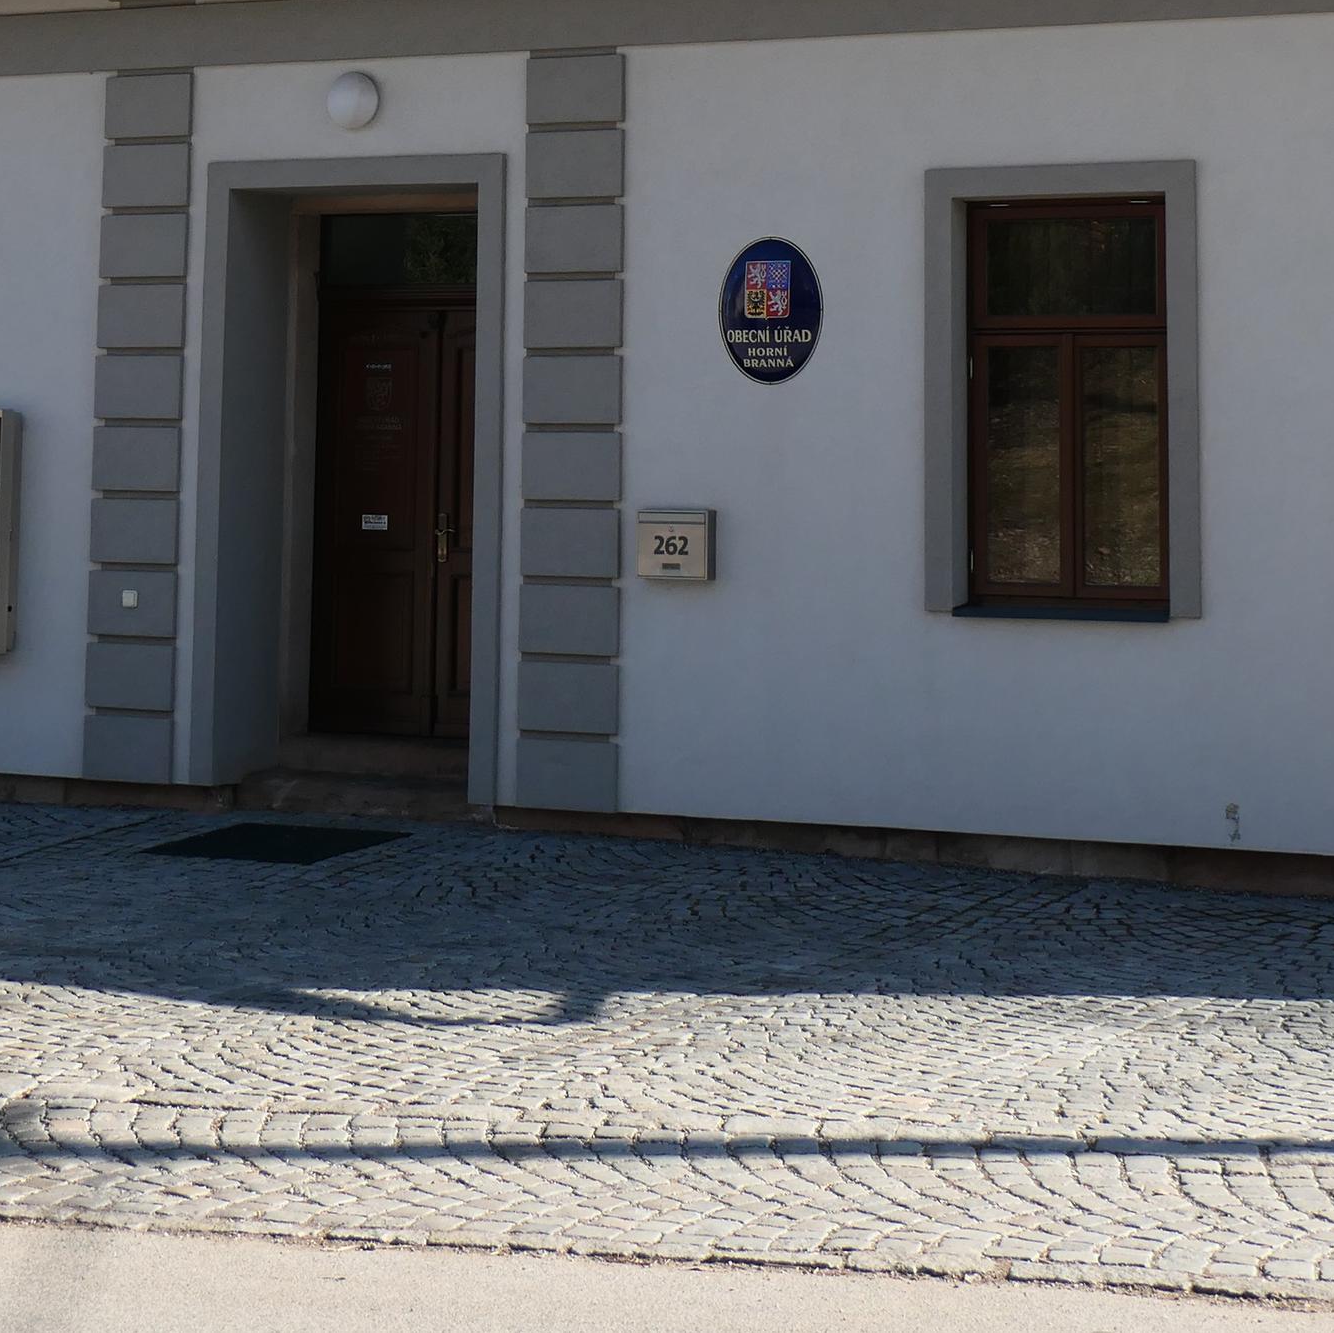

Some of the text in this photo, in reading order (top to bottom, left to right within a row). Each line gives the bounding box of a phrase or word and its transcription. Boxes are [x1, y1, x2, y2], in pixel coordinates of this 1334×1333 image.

[727, 325, 812, 343] OBECNÍ ÚŘAD
[748, 345, 788, 357] HORNÍ
[743, 356, 794, 368] BRANNÁ
[654, 535, 689, 556] 262
